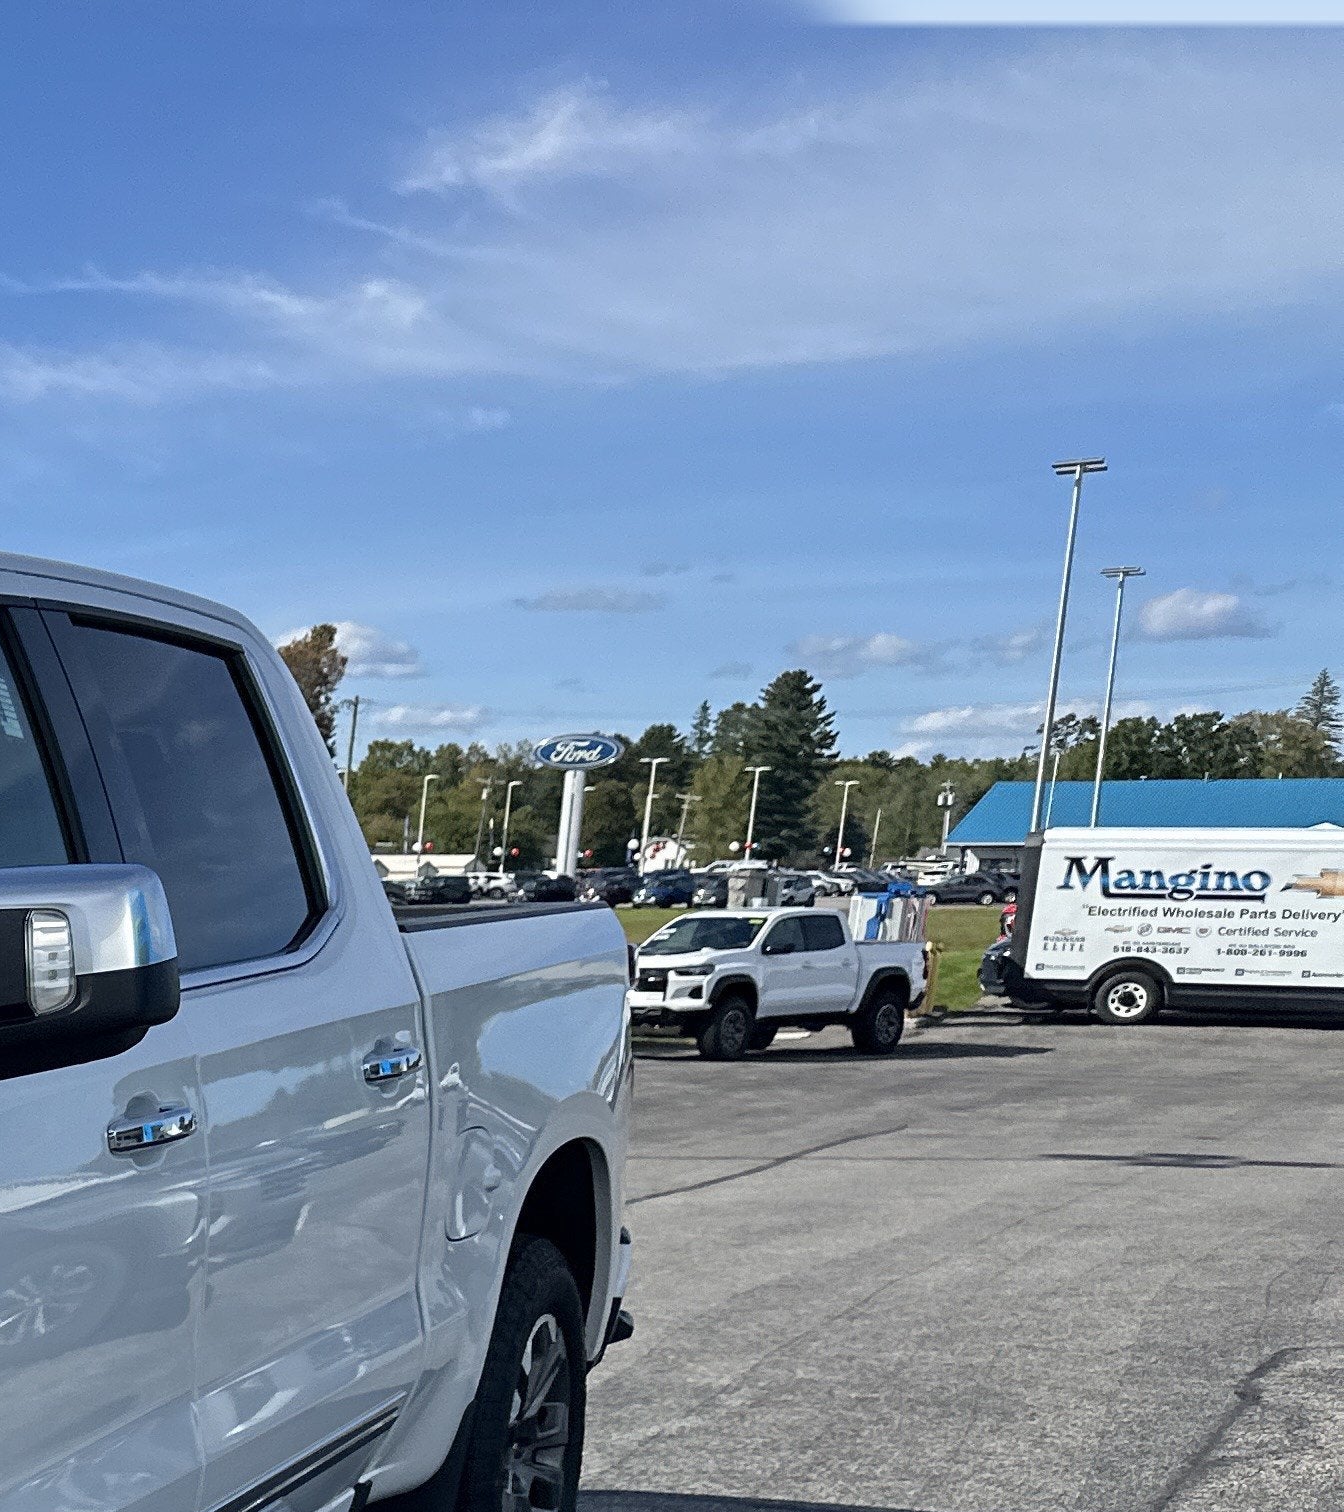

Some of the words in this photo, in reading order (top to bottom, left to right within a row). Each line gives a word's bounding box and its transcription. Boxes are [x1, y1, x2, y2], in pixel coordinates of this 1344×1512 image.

[550, 740, 603, 762] Ford
[1057, 856, 1272, 902] Mangino
[1161, 906, 1236, 920] Wholesale
[1239, 908, 1278, 921] Parts
[1217, 926, 1270, 938] Certified
[1273, 926, 1319, 939] Service
